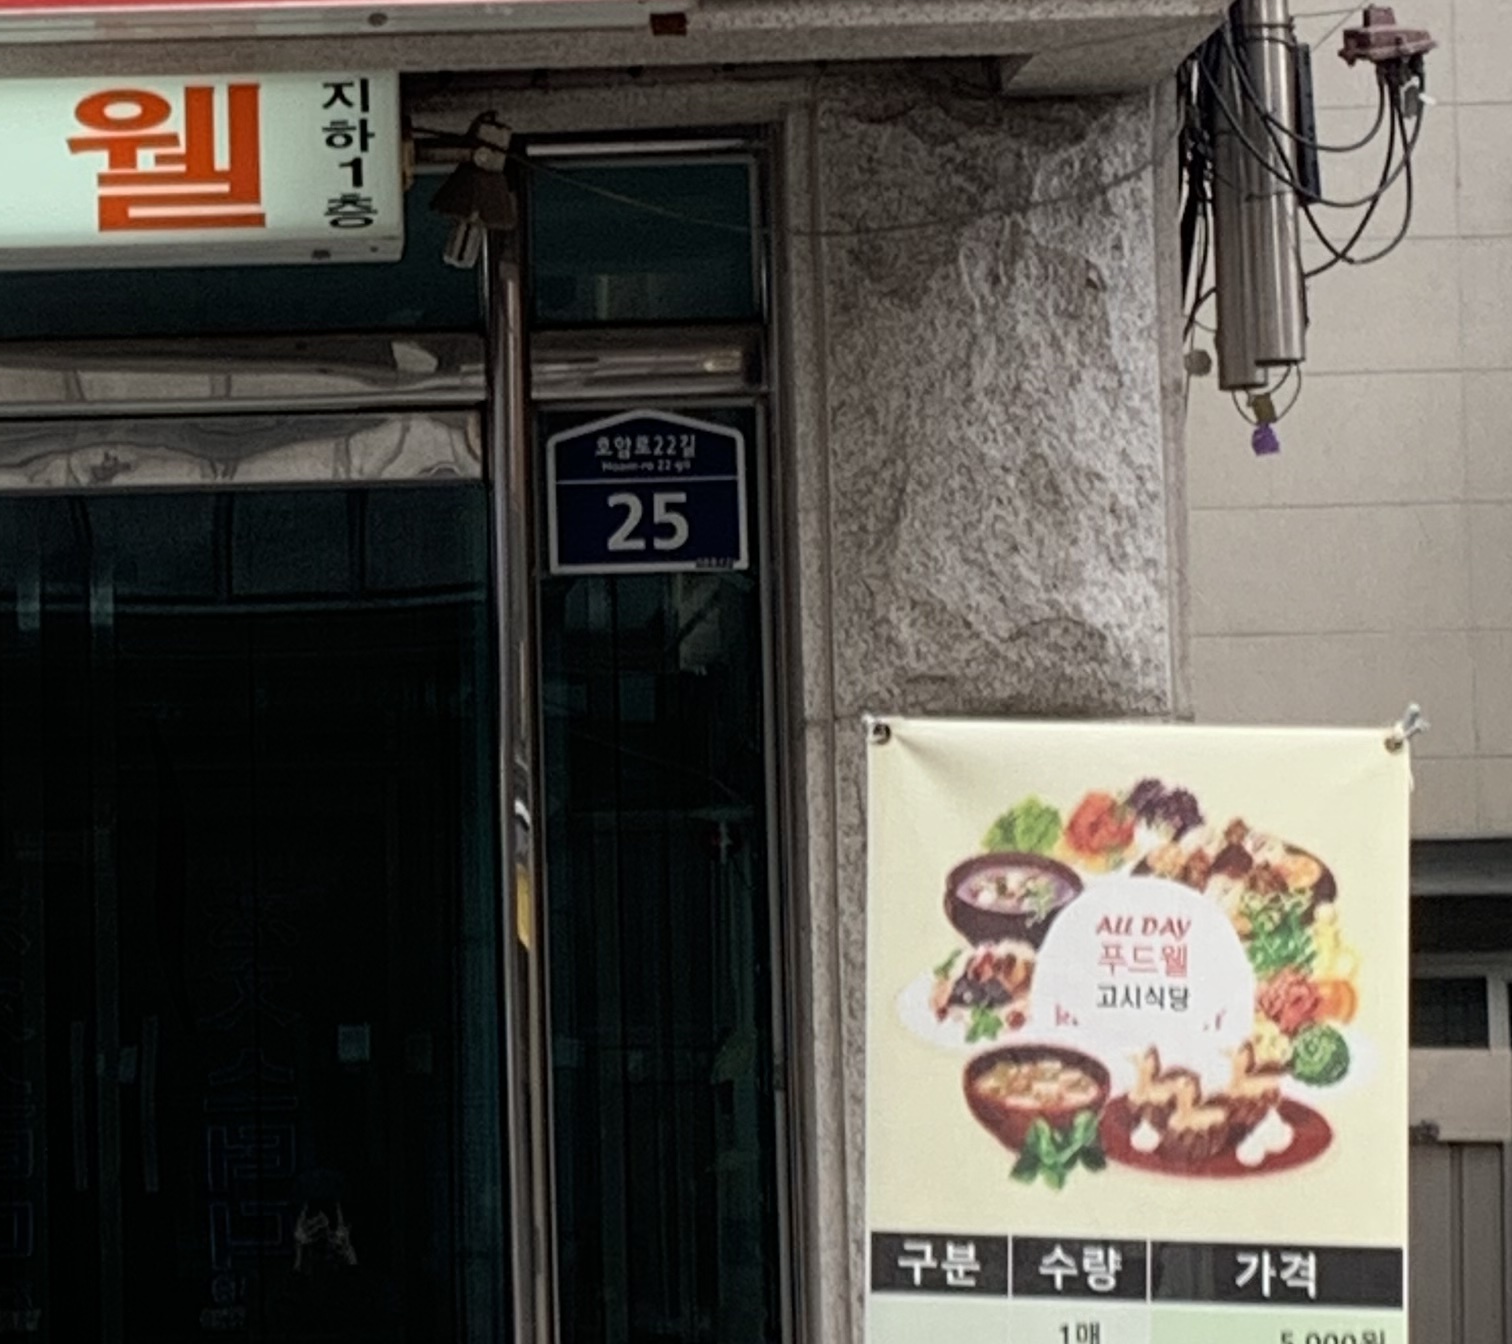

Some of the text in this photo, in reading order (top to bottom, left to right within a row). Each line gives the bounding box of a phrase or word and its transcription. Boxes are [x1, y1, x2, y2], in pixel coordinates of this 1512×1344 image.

[322, 77, 377, 230] 지하1층
[607, 491, 689, 551] 25
[1098, 943, 1188, 976] 푸드웰
[1096, 983, 1190, 1012] 고시식당
[897, 1242, 981, 1287] 구분
[1039, 1245, 1122, 1291] 수량
[1235, 1250, 1317, 1298] 가격
